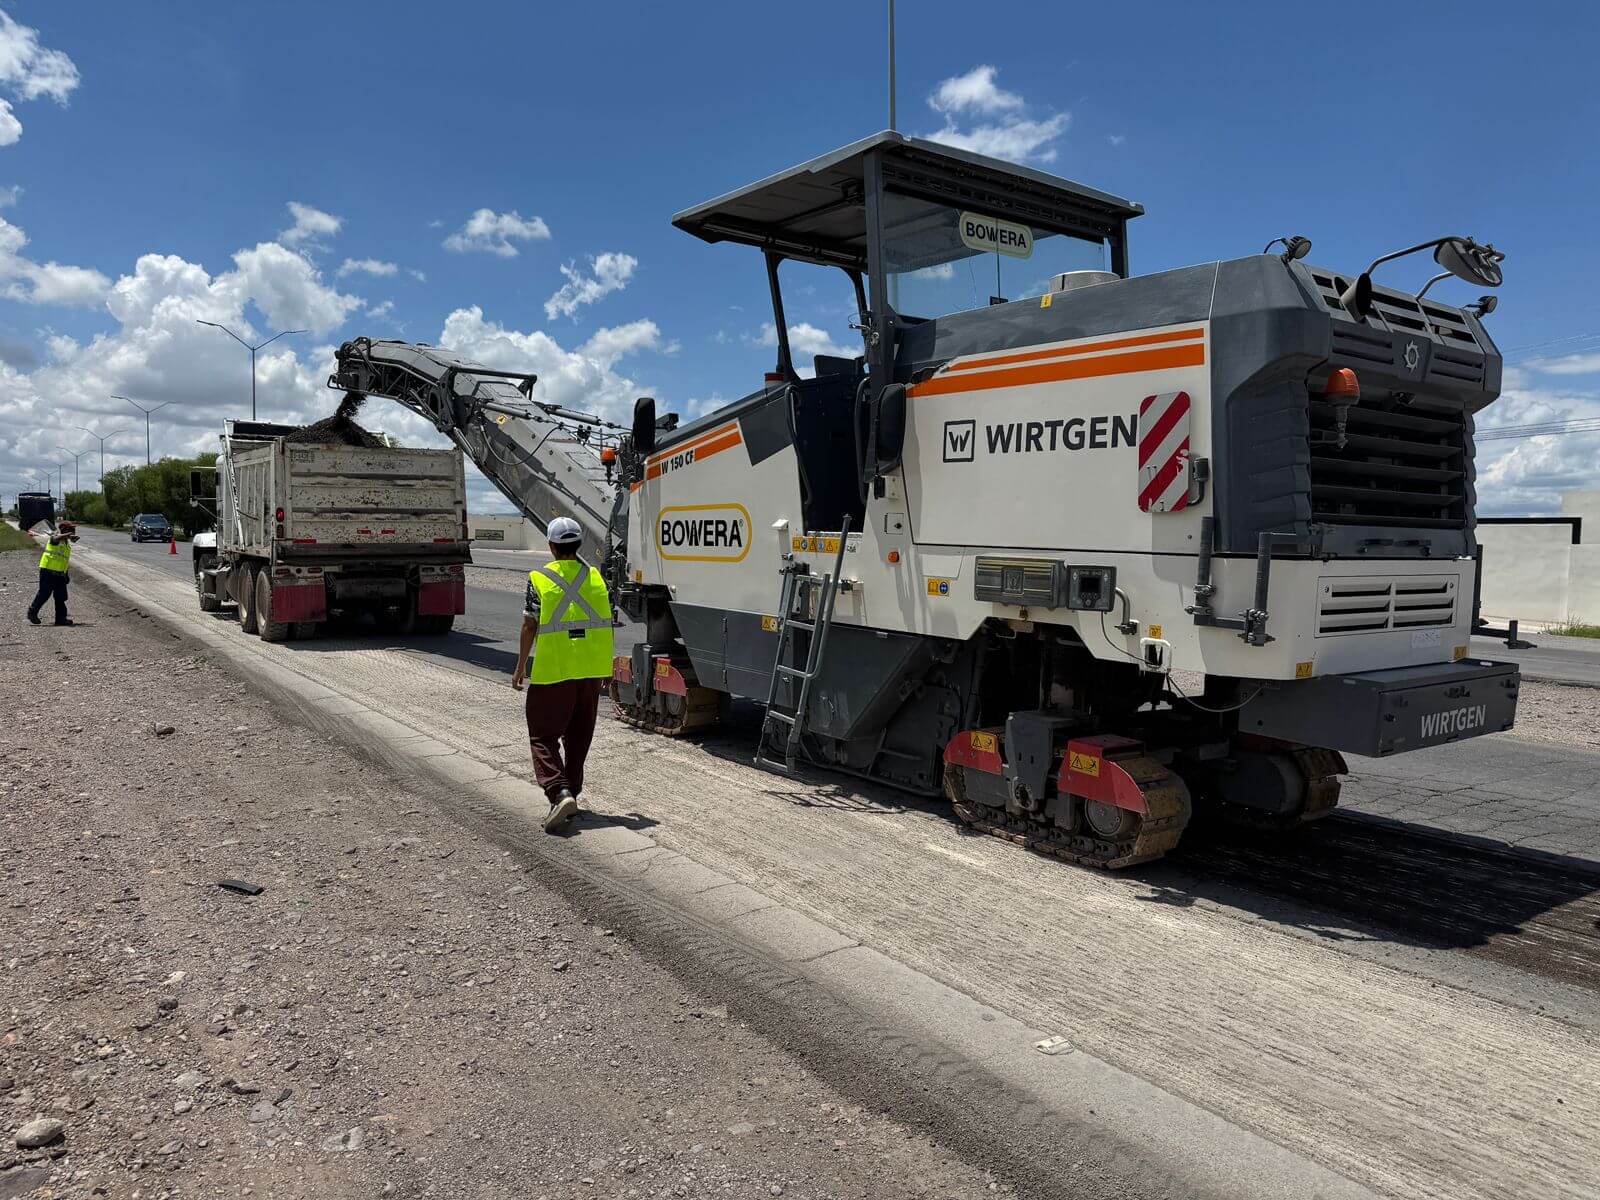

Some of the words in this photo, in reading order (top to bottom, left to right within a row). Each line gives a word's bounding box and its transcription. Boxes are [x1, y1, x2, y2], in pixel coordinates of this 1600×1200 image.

[966, 221, 1027, 248] BOWERA
[949, 430, 971, 452] W
[986, 414, 1137, 454] WIRTGEN
[661, 460, 669, 475] W
[670, 454, 684, 471] 150
[685, 449, 694, 465] CF
[1421, 705, 1486, 738] WIRTGEN
